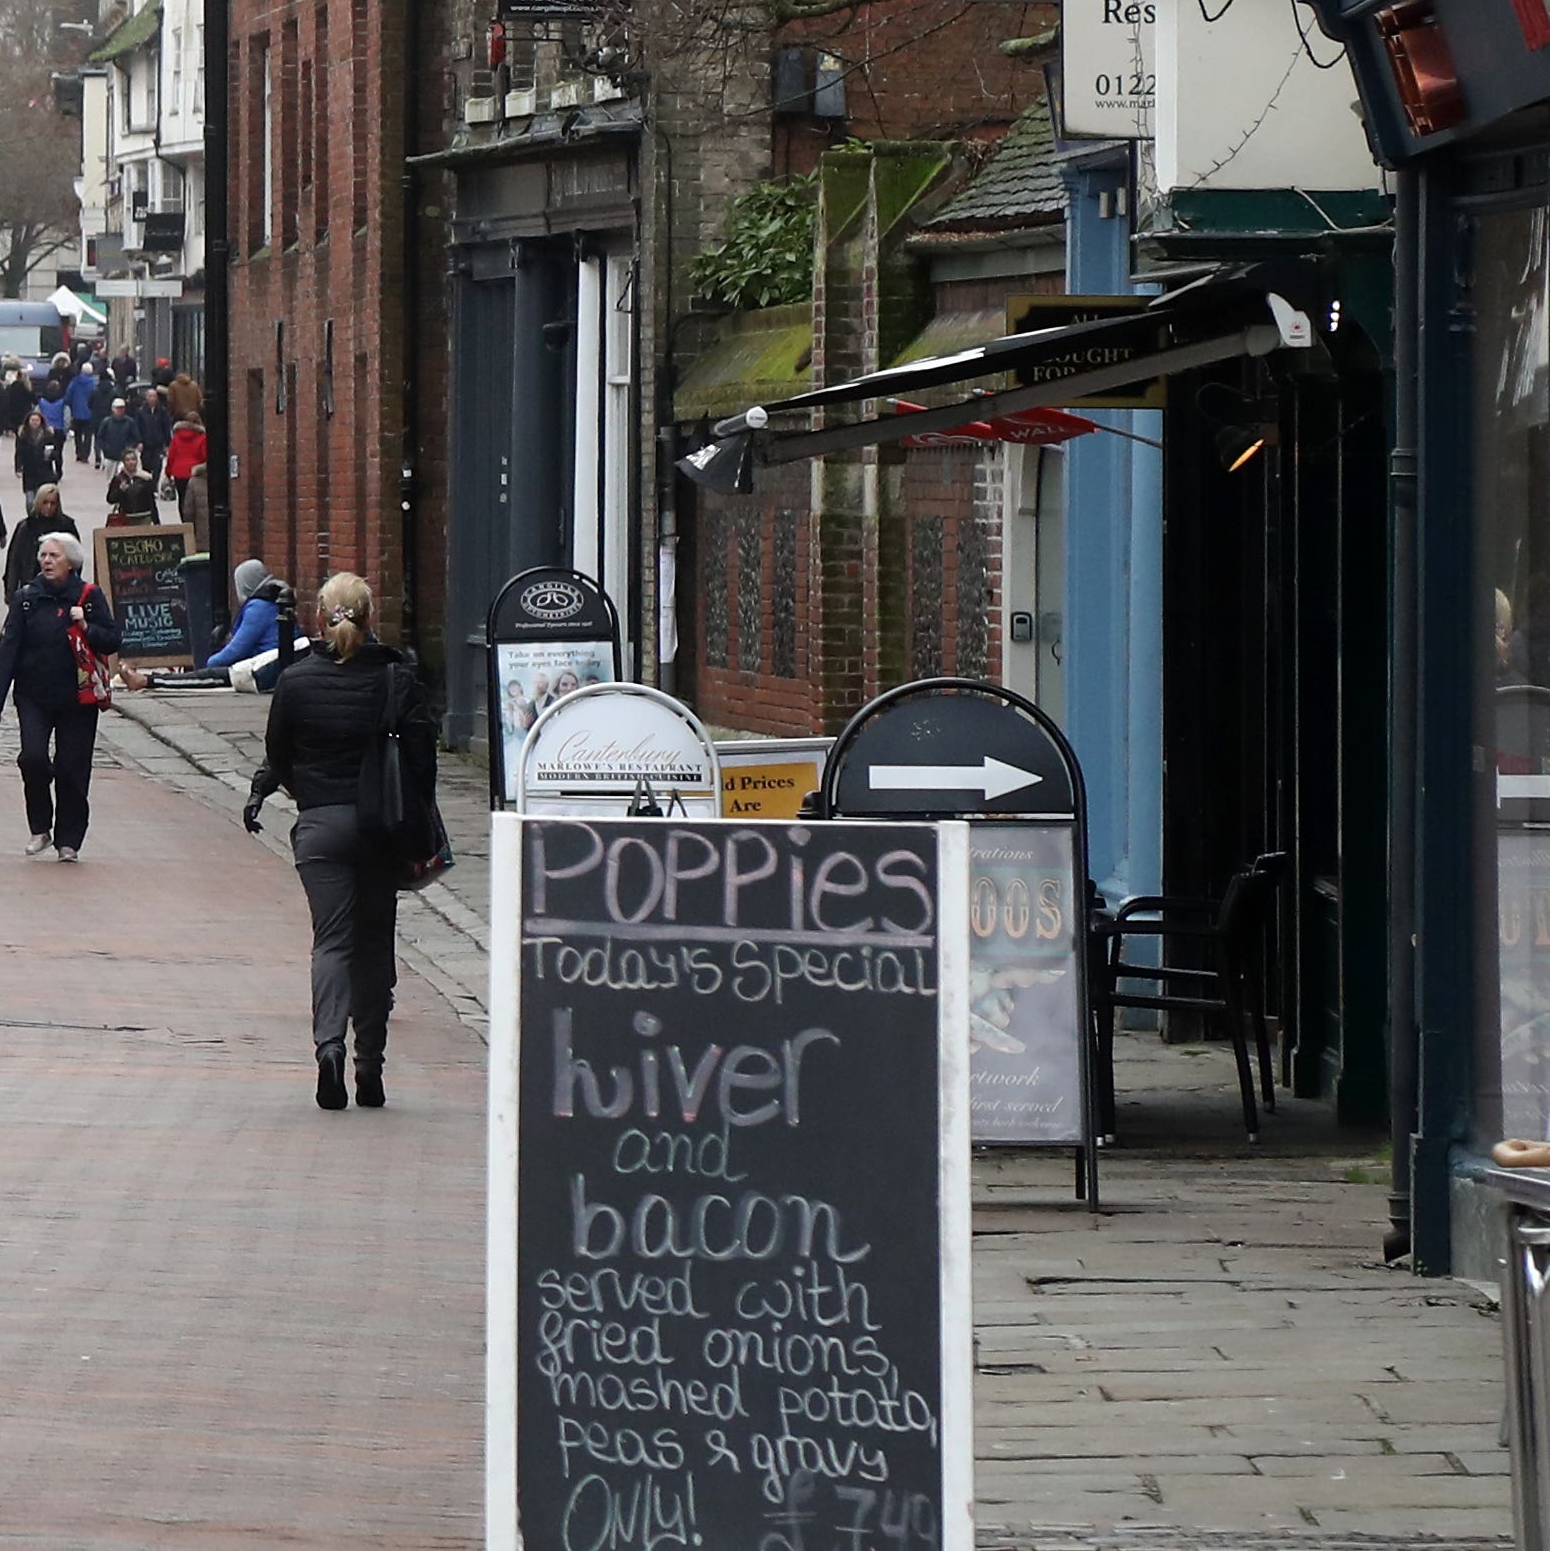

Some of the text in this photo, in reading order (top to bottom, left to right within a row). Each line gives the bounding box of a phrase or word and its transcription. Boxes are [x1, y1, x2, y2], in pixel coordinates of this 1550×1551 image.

[127, 604, 171, 618] LIVE
[537, 761, 703, 773] MARLOWE'S RESTAURANT
[556, 729, 682, 765] Canterbury
[538, 772, 590, 781] MODERN
[739, 776, 796, 791] Prices
[729, 799, 762, 813] Are
[614, 1123, 748, 1184] and
[570, 1174, 870, 1265] bacon
[537, 1262, 882, 1333] served with
[537, 1312, 676, 1375] fried
[547, 1361, 748, 1421] mashed
[559, 1414, 685, 1478] peas
[752, 1433, 889, 1504] gravy
